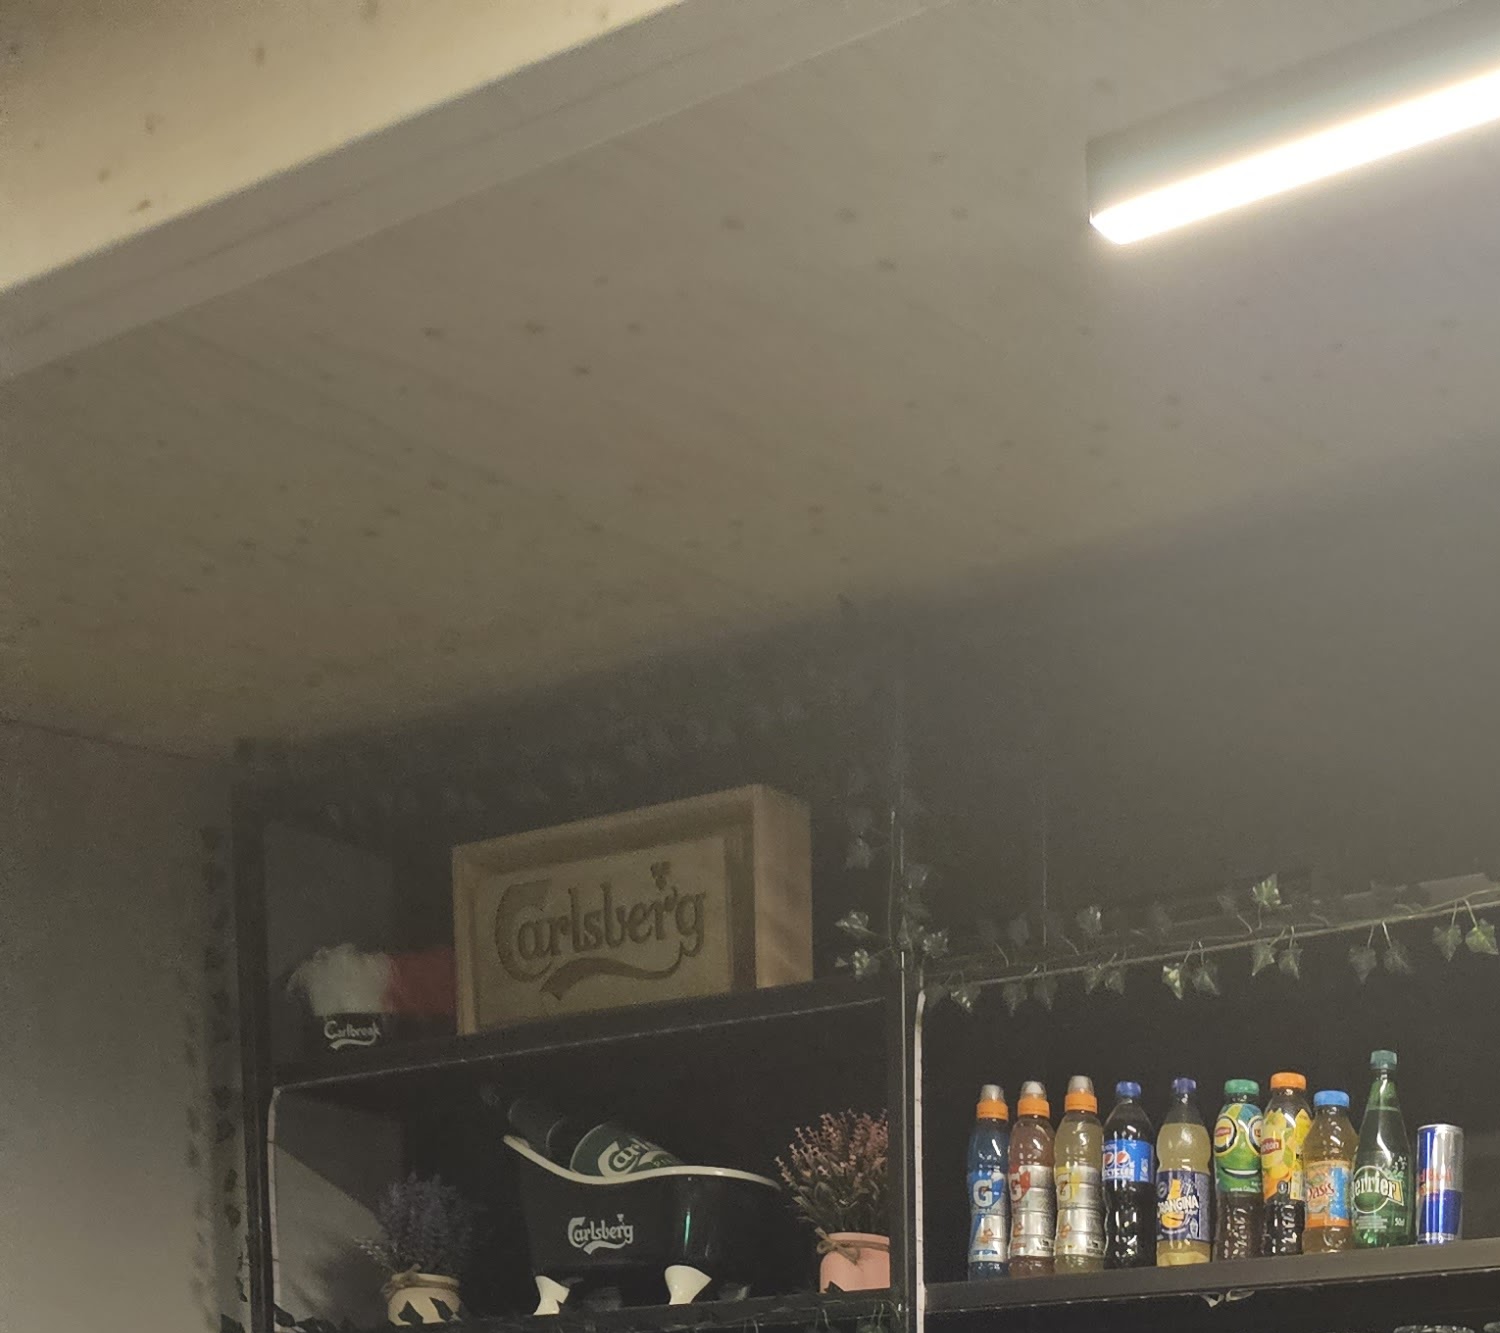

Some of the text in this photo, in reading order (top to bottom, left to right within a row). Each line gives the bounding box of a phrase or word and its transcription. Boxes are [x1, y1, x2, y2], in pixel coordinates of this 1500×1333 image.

[494, 877, 706, 998] Carlsberg
[973, 1180, 993, 1208] G
[567, 1216, 634, 1254] Carlsberg
